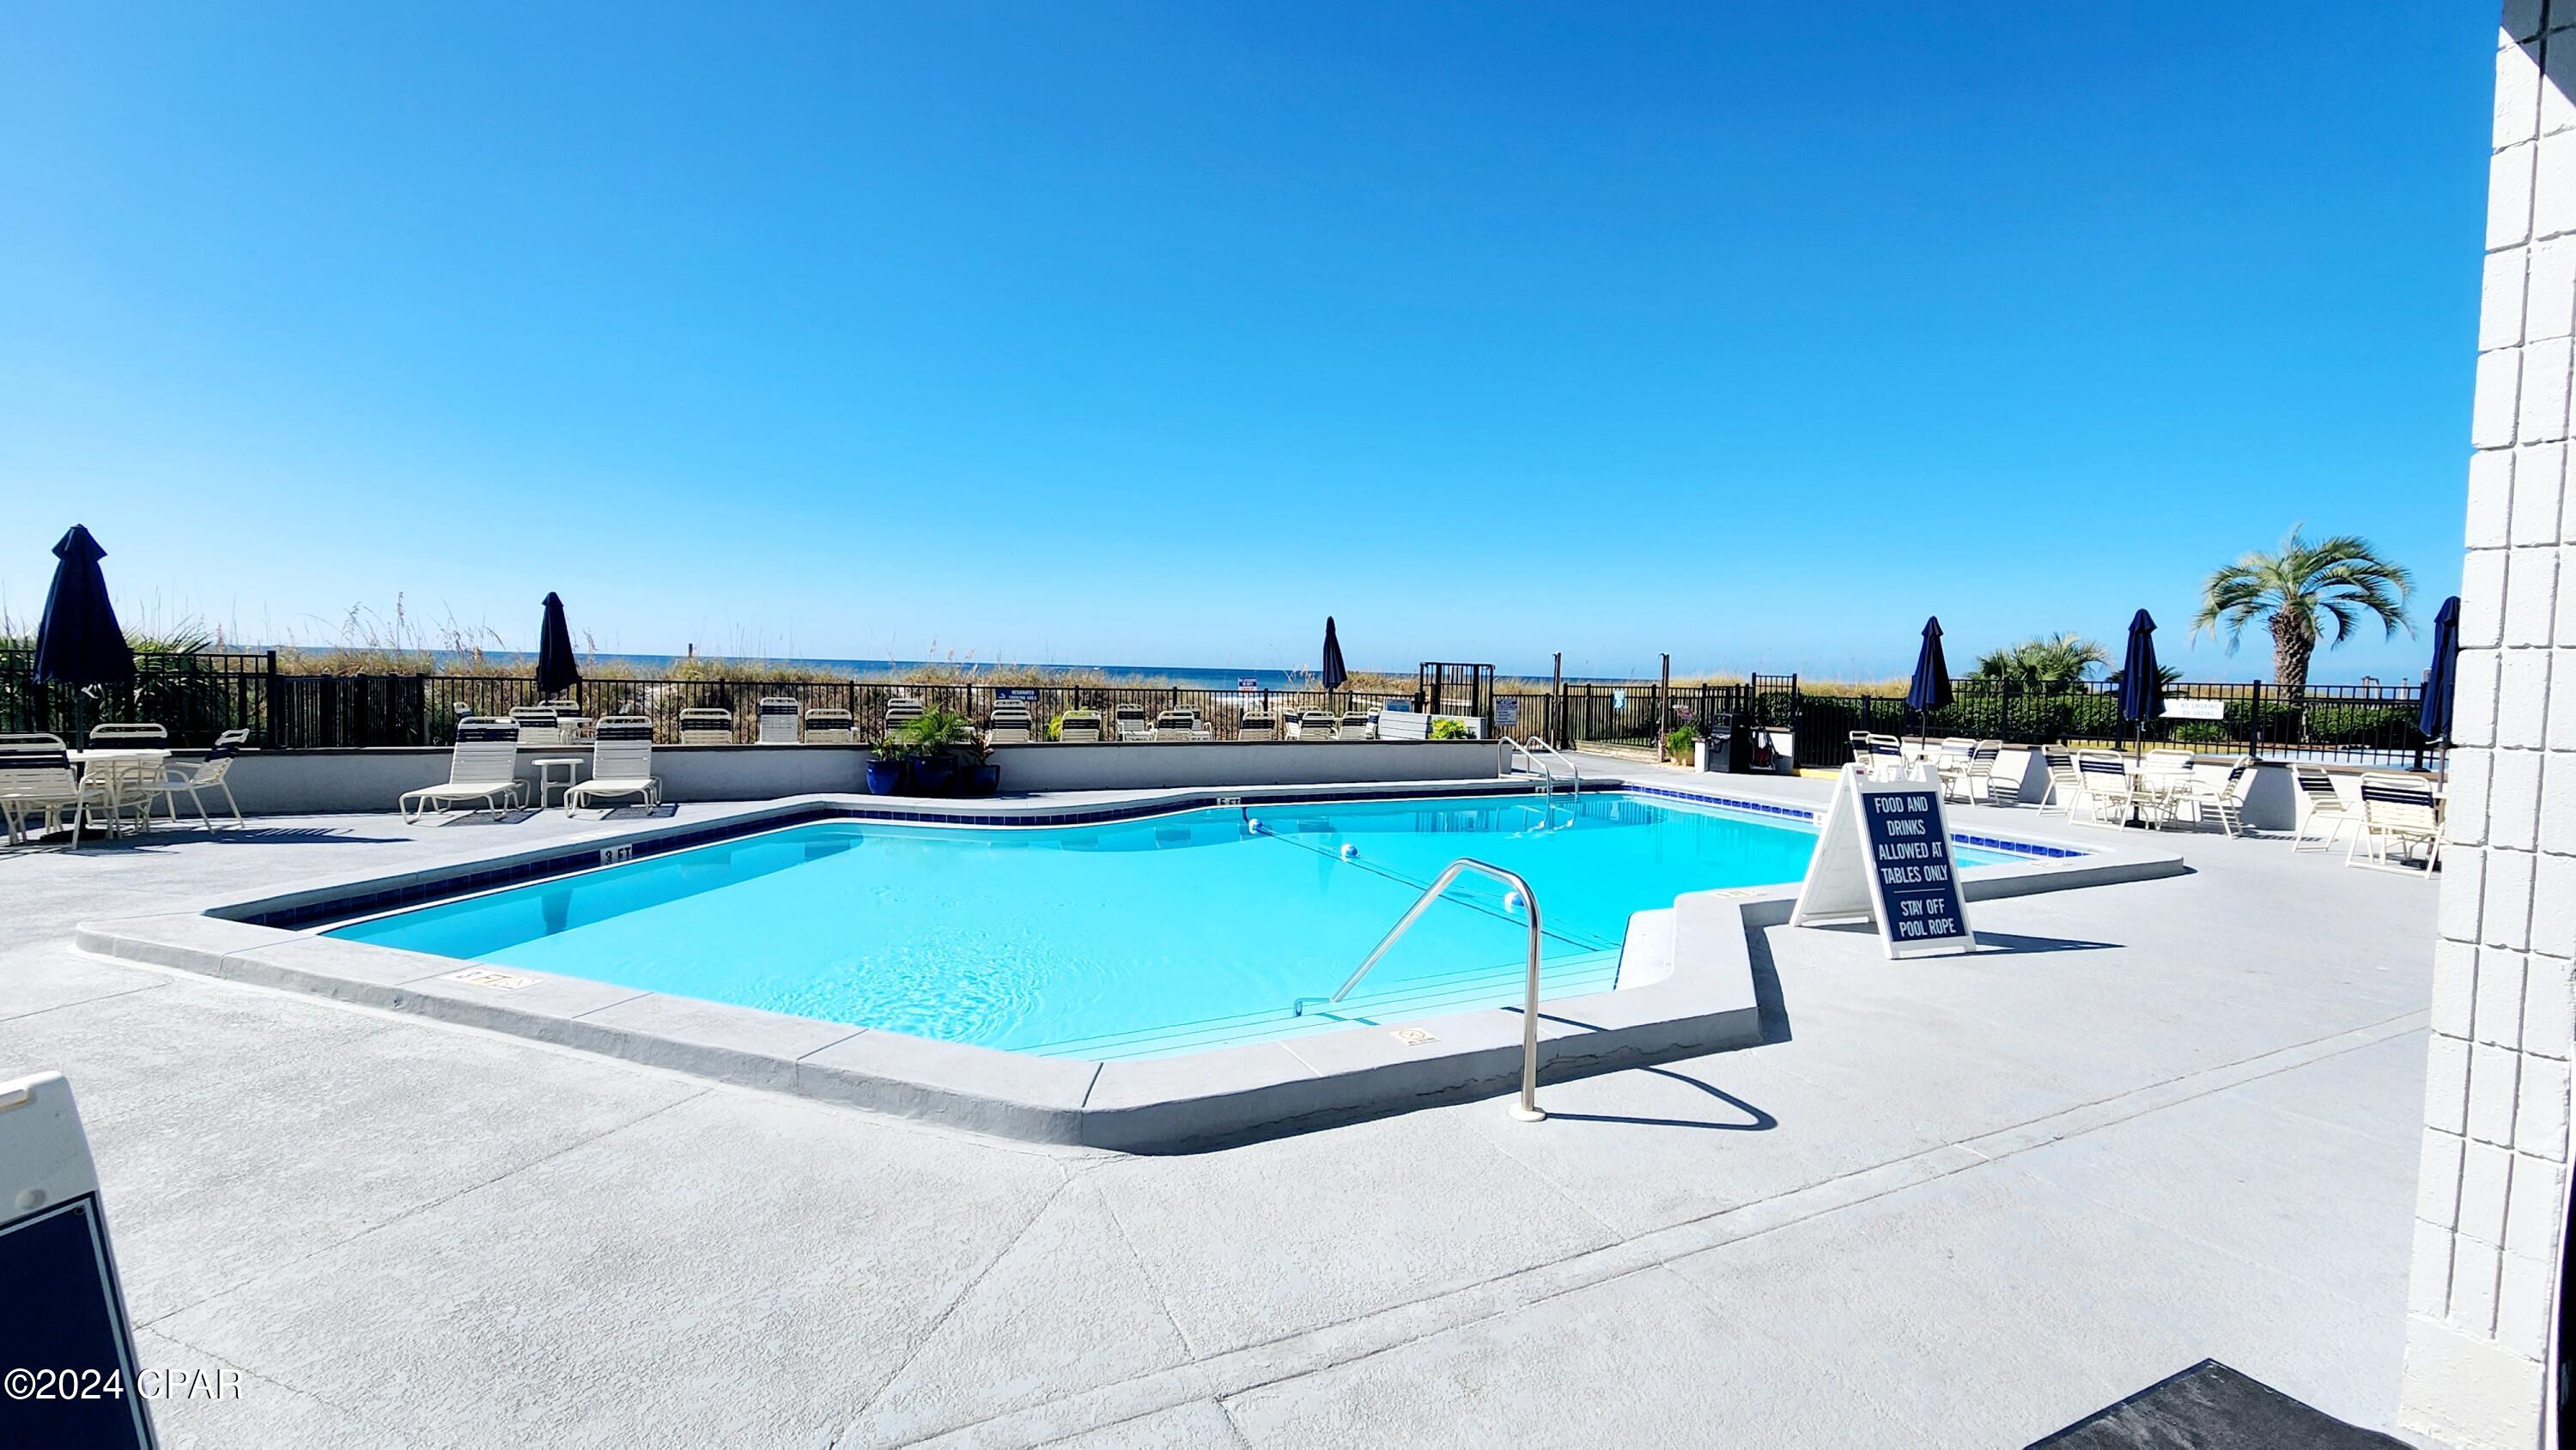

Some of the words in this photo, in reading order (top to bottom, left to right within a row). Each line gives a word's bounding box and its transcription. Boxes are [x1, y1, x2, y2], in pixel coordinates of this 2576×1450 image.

[1874, 797, 1905, 814] FOOD
[1907, 796, 1929, 812] AND
[1886, 819, 1926, 836] DRINKS
[605, 850, 613, 860] 3
[617, 846, 631, 860] FT
[1878, 842, 1929, 860] ALLOWED
[1932, 841, 1943, 858] AT
[1880, 866, 1923, 884] TABLES
[1923, 865, 1948, 882] ONLY
[1900, 900, 1923, 917] STAY
[1925, 898, 1945, 915] OFF
[1899, 919, 1928, 937] POOL
[1928, 918, 1957, 935] ROPE
